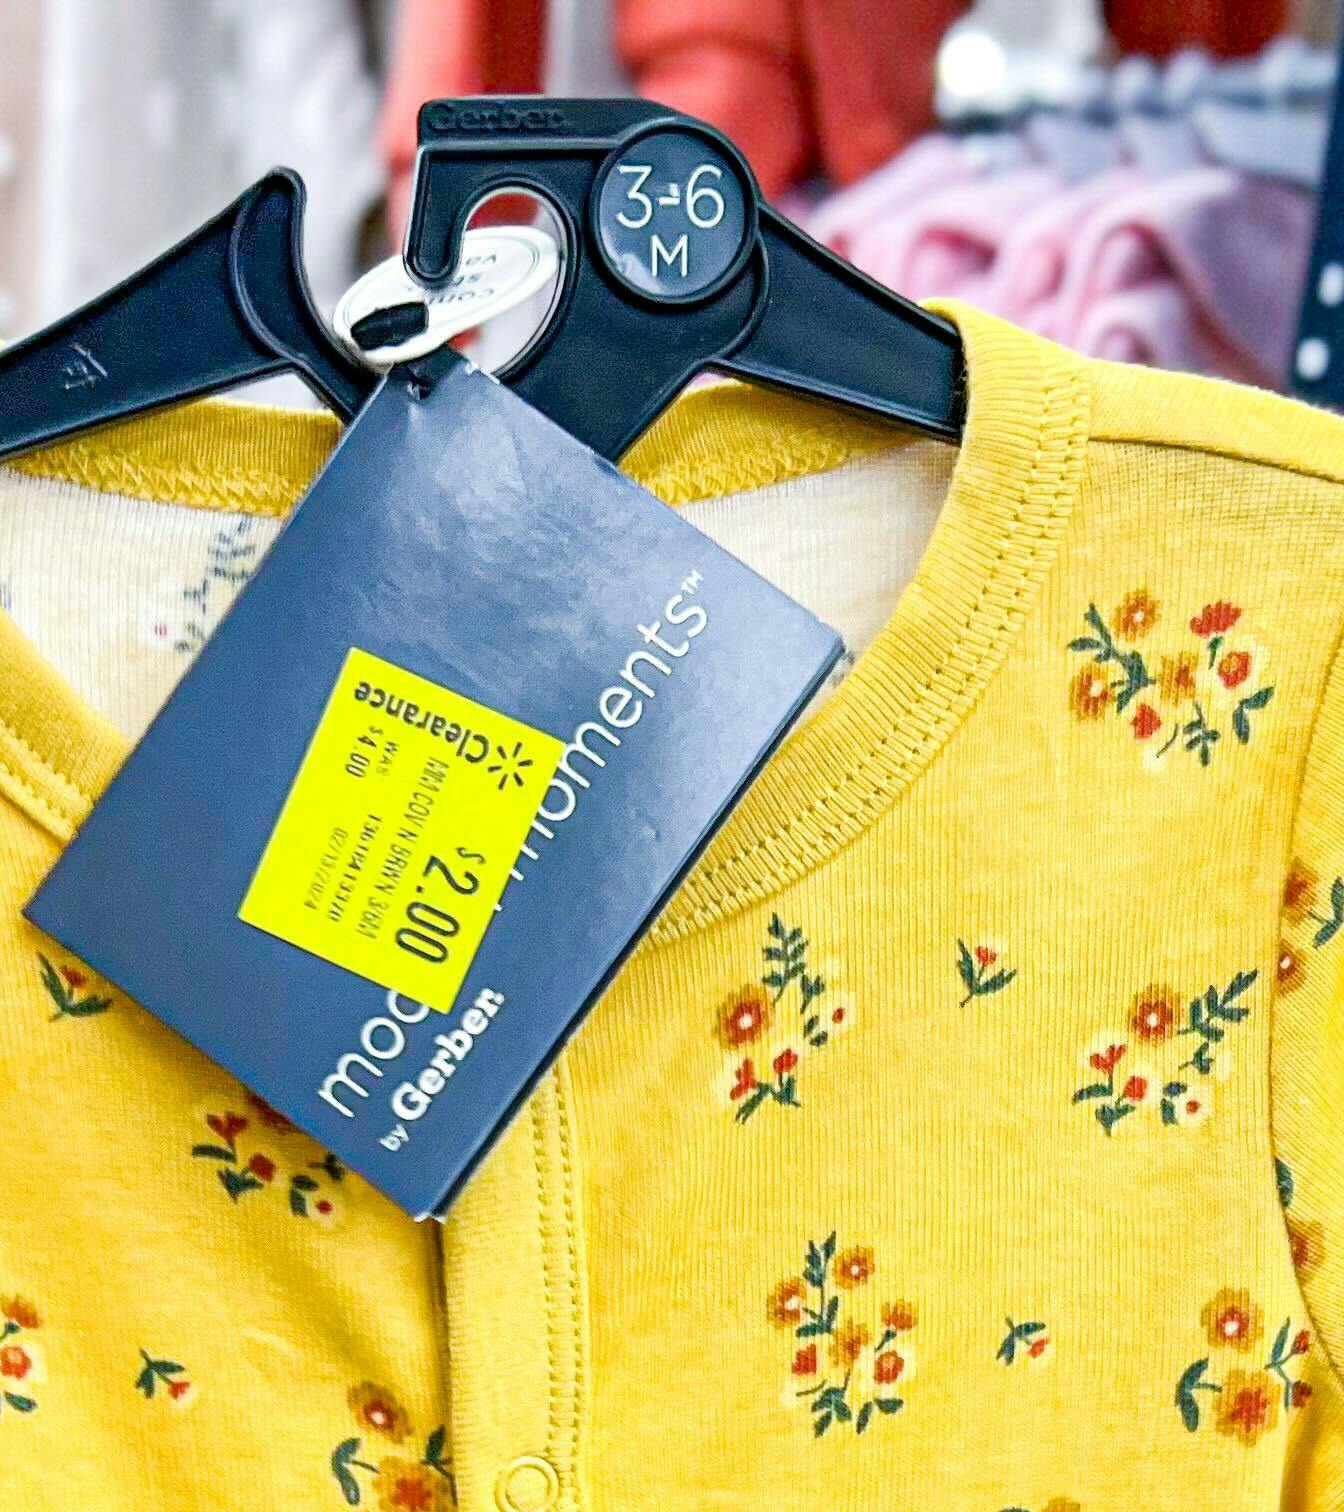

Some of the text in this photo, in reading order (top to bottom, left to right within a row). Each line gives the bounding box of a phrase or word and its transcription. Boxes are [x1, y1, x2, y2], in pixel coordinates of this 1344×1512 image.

[616, 164, 725, 229] 3-6
[651, 234, 689, 278] M
[353, 681, 490, 765] Clearance
[345, 725, 384, 778] $4.00
[377, 741, 399, 776] WAS
[403, 792, 434, 831] COV
[372, 843, 412, 896] BRWN
[395, 846, 486, 964] $2.00
[380, 1122, 412, 1152] by
